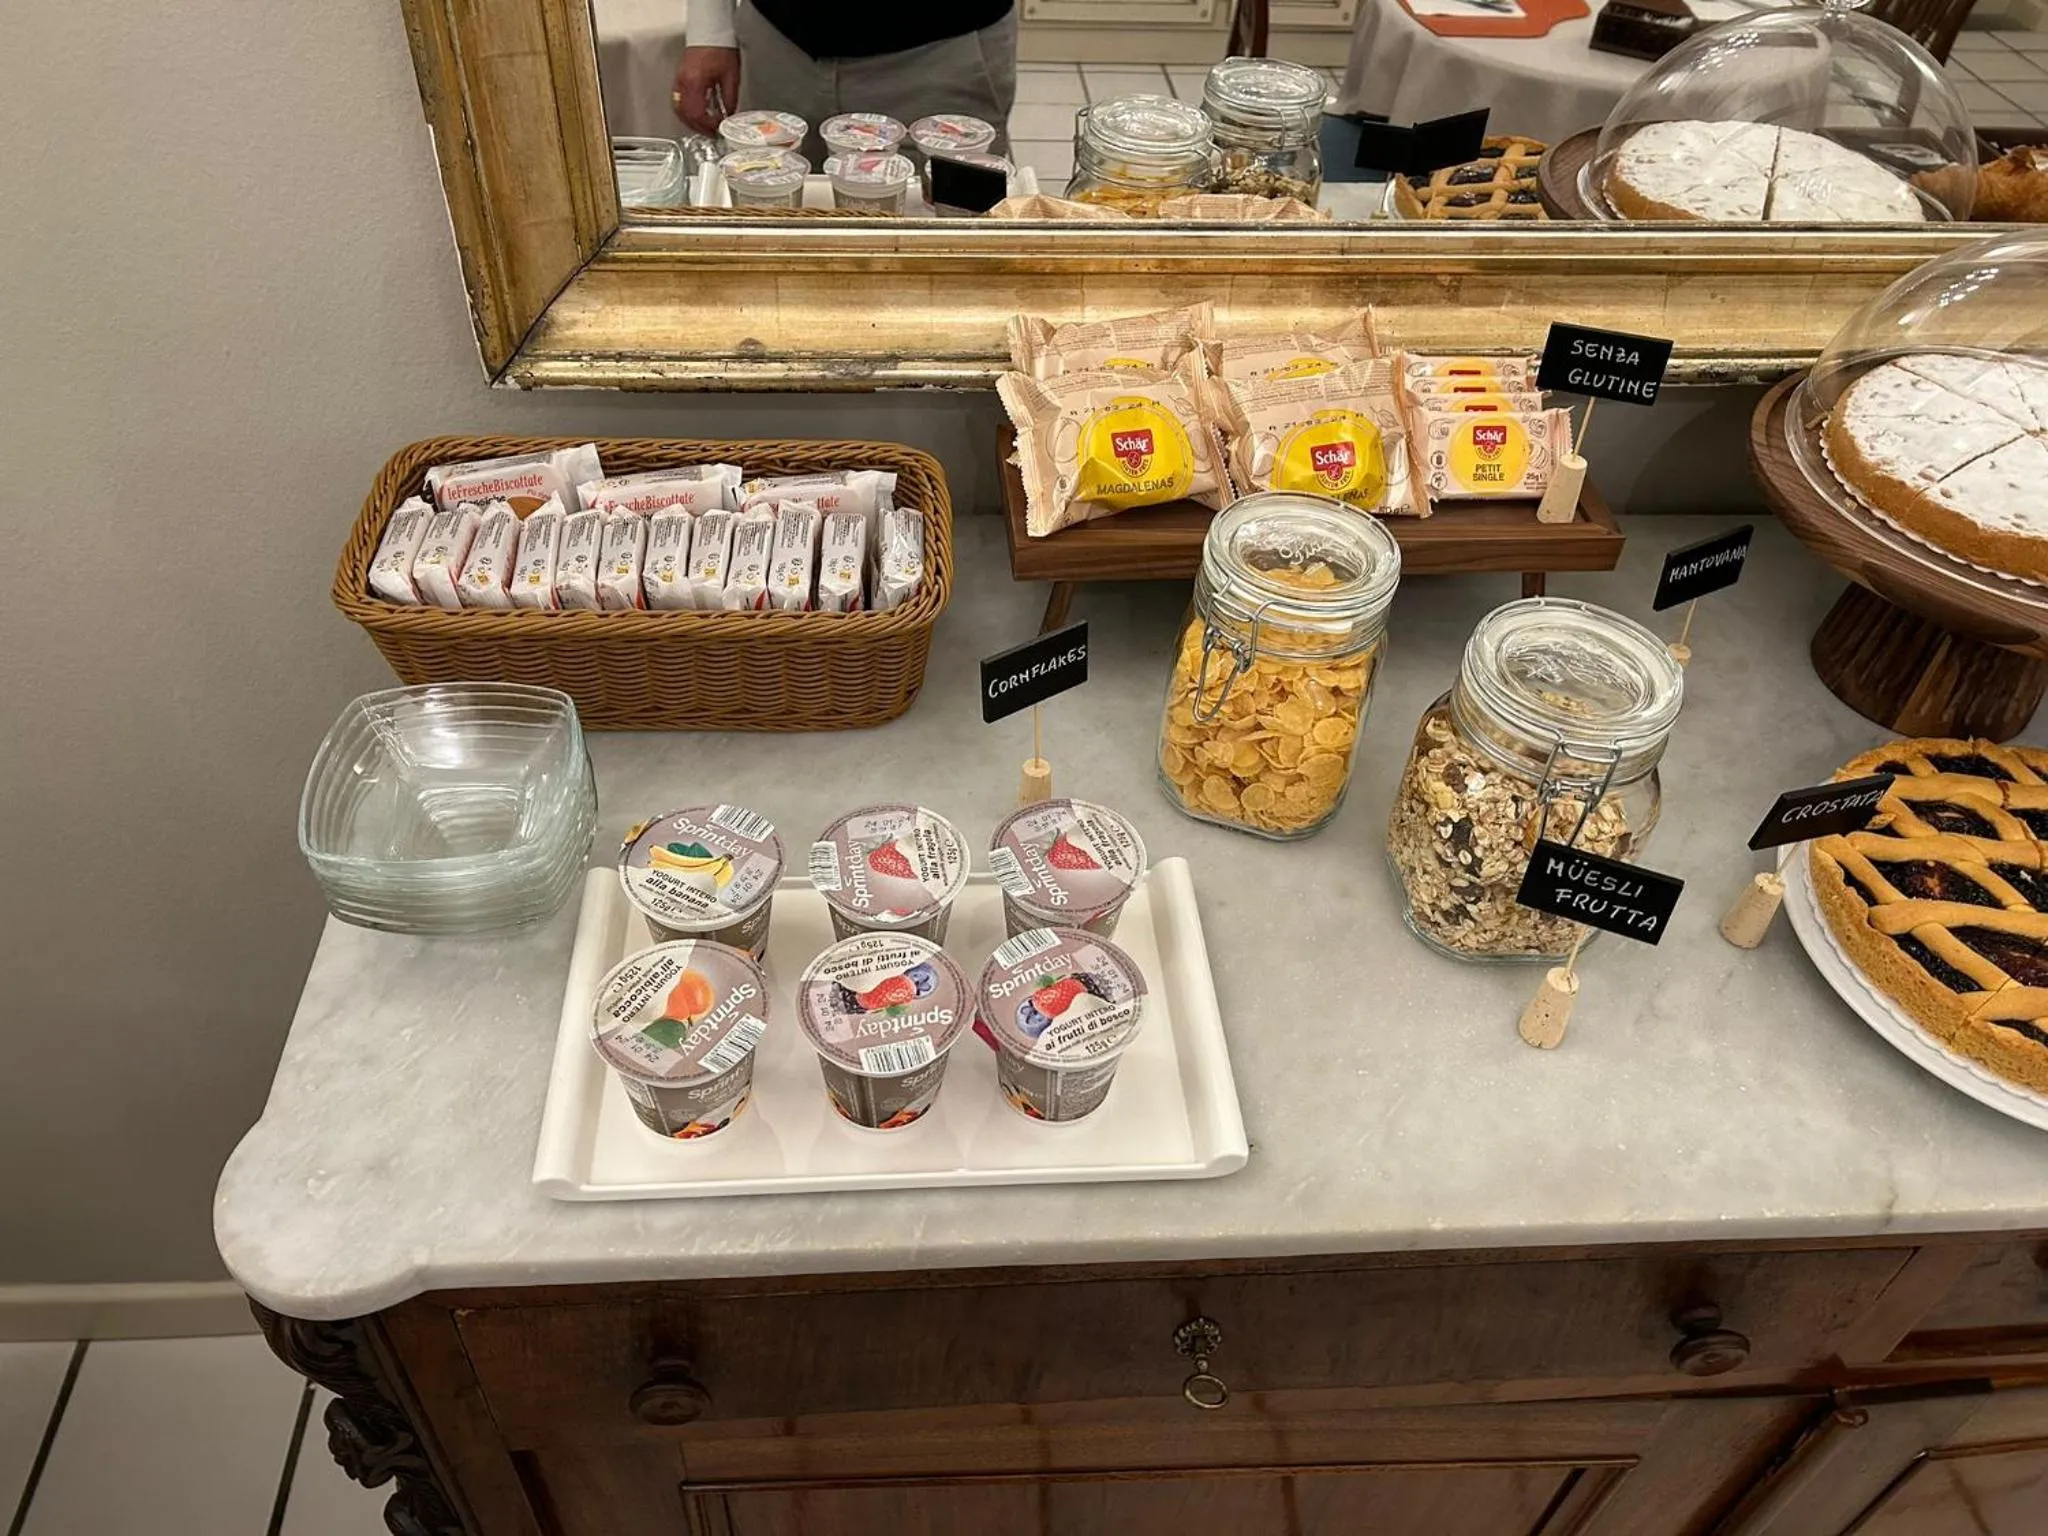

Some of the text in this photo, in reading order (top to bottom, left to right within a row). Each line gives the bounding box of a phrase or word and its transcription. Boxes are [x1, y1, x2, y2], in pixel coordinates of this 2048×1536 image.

[1570, 339, 1640, 365] SENZA
[1568, 368, 1657, 398] GLUTINE
[1115, 436, 1149, 452] Schär
[1476, 429, 1505, 443] Schär
[1315, 450, 1348, 465] Schär
[1475, 463, 1501, 473] PETIT
[1096, 478, 1174, 495] MAGDALENAS
[1472, 473, 1505, 482] SINGLE
[1669, 544, 1747, 583] MANTOVANA
[988, 645, 1086, 698] CORNFLAKES
[1781, 788, 1886, 823] CROSTATA
[672, 816, 753, 859] Sprintday
[924, 829, 938, 860] fragola
[918, 853, 931, 883] YOGURT
[928, 861, 940, 880] alla
[1107, 848, 1122, 866] alla
[652, 869, 685, 888] YOGURT
[846, 840, 874, 908] Sprintday
[1020, 841, 1069, 906] Sprintday
[1546, 857, 1644, 898] MÜESLI
[645, 878, 668, 894] alla
[668, 888, 709, 909] banana
[1555, 888, 1658, 932] FRUTTA
[860, 939, 884, 949] 125g
[877, 951, 906, 966] frutti
[909, 950, 921, 959] ai
[618, 965, 642, 984] 125g
[823, 960, 859, 974] bosco
[835, 959, 915, 981] YOGURT INTERO
[861, 957, 874, 966] di
[988, 952, 1074, 999] Sprintday
[613, 958, 675, 1018] all'albicocca
[650, 965, 683, 994] YOGURT
[622, 993, 652, 1023] INTERO
[679, 983, 756, 1056] Sprintday
[856, 1005, 954, 1039] Sprintday
[1047, 1017, 1083, 1037] YOGURT
[1085, 1004, 1116, 1023] INTERO
[1045, 1040, 1056, 1052] ai
[1057, 1028, 1086, 1048] frutti
[1088, 1018, 1099, 1031] di
[1100, 1008, 1131, 1027] bosco
